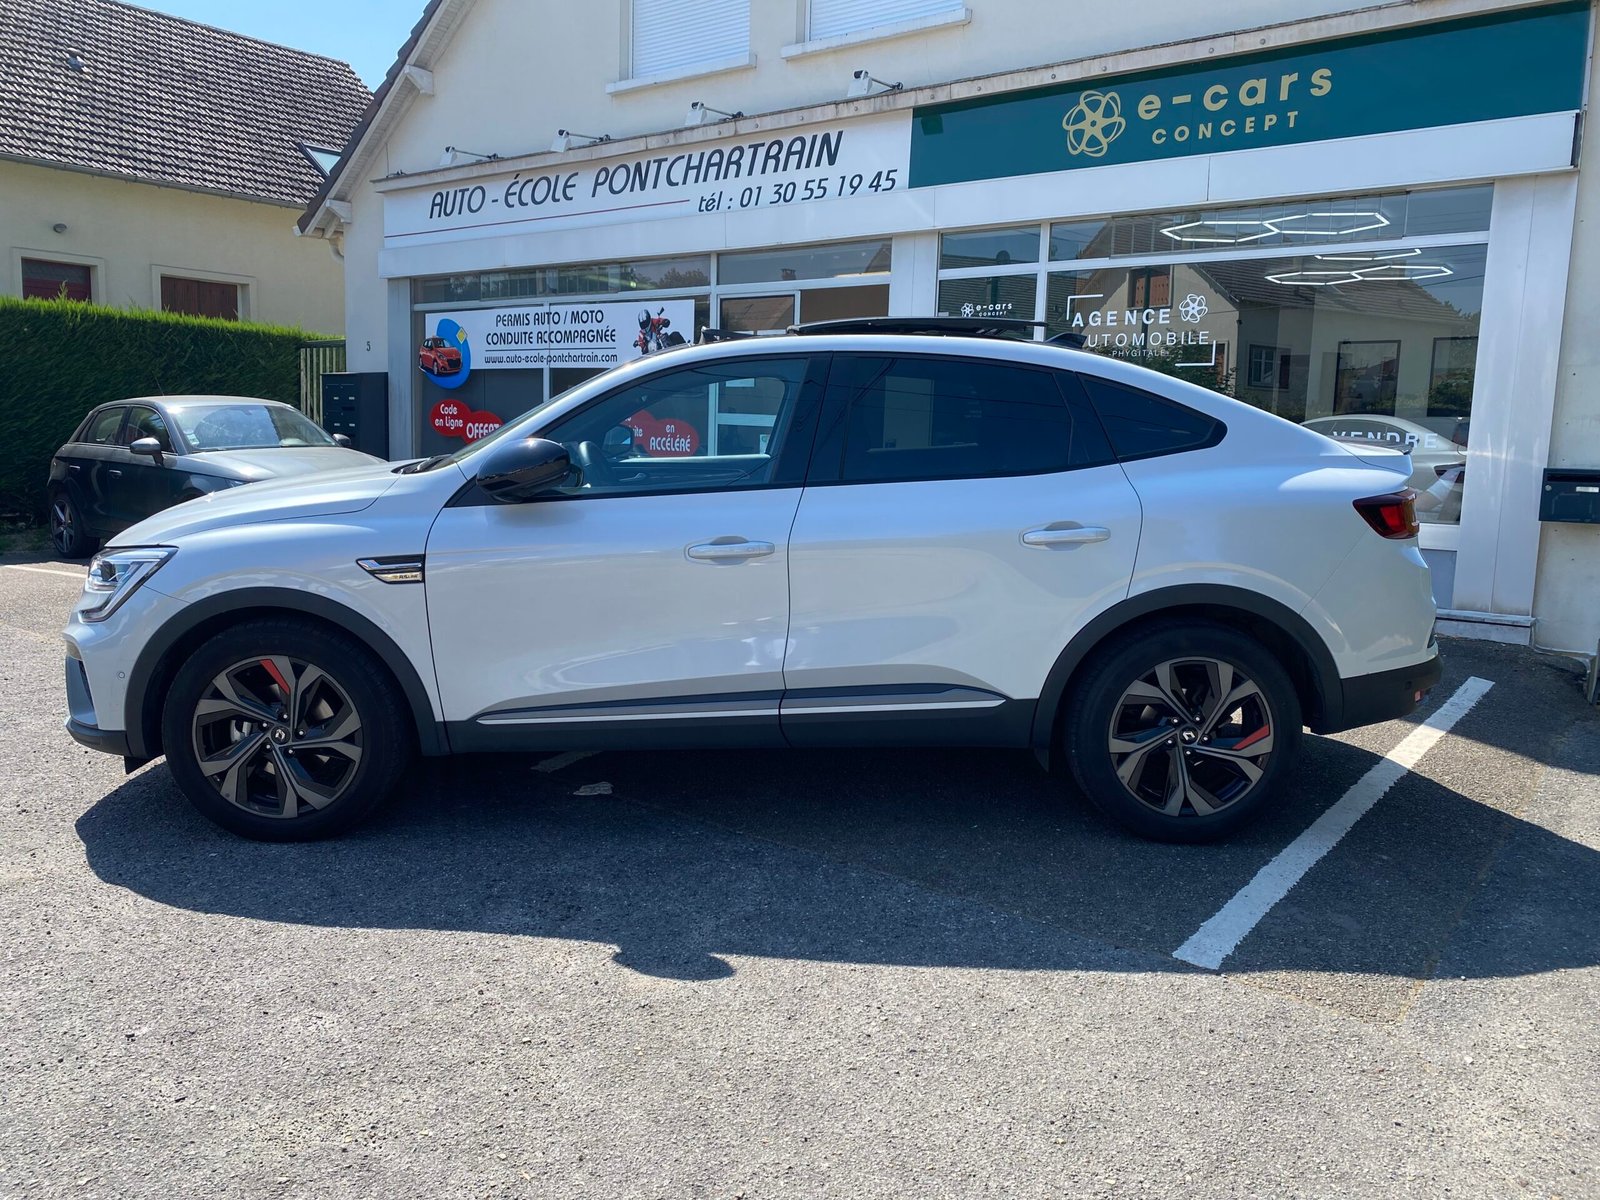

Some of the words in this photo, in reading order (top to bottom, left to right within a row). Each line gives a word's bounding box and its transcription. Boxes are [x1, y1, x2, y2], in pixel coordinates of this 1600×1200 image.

[1137, 68, 1332, 120] e-cars
[1152, 111, 1298, 145] CONCEPT
[591, 130, 844, 198] PONTCHARTRAIN
[698, 189, 722, 213] tél
[739, 186, 763, 208] 01
[769, 181, 797, 204] 30
[801, 177, 829, 201] 55
[837, 173, 863, 197] 19
[868, 169, 898, 193] 45
[976, 303, 1012, 311] e-cars
[495, 313, 530, 327] PERMIS
[533, 312, 560, 326] AUTO
[570, 310, 604, 324] MOTO
[1071, 308, 1171, 327] AGENCE
[486, 331, 533, 345] CONDUITE
[536, 325, 616, 344] ACCOMPAGNÉE
[1087, 331, 1210, 348] UTOMOBILE
[366, 340, 371, 352] 5
[484, 352, 618, 365] www.auto-ecole-pontchartrain.com
[440, 403, 458, 415] Code
[434, 418, 444, 427] en
[445, 415, 464, 430] Ligne
[665, 424, 675, 433] en
[649, 435, 691, 452] ACCÉLÉRÉ
